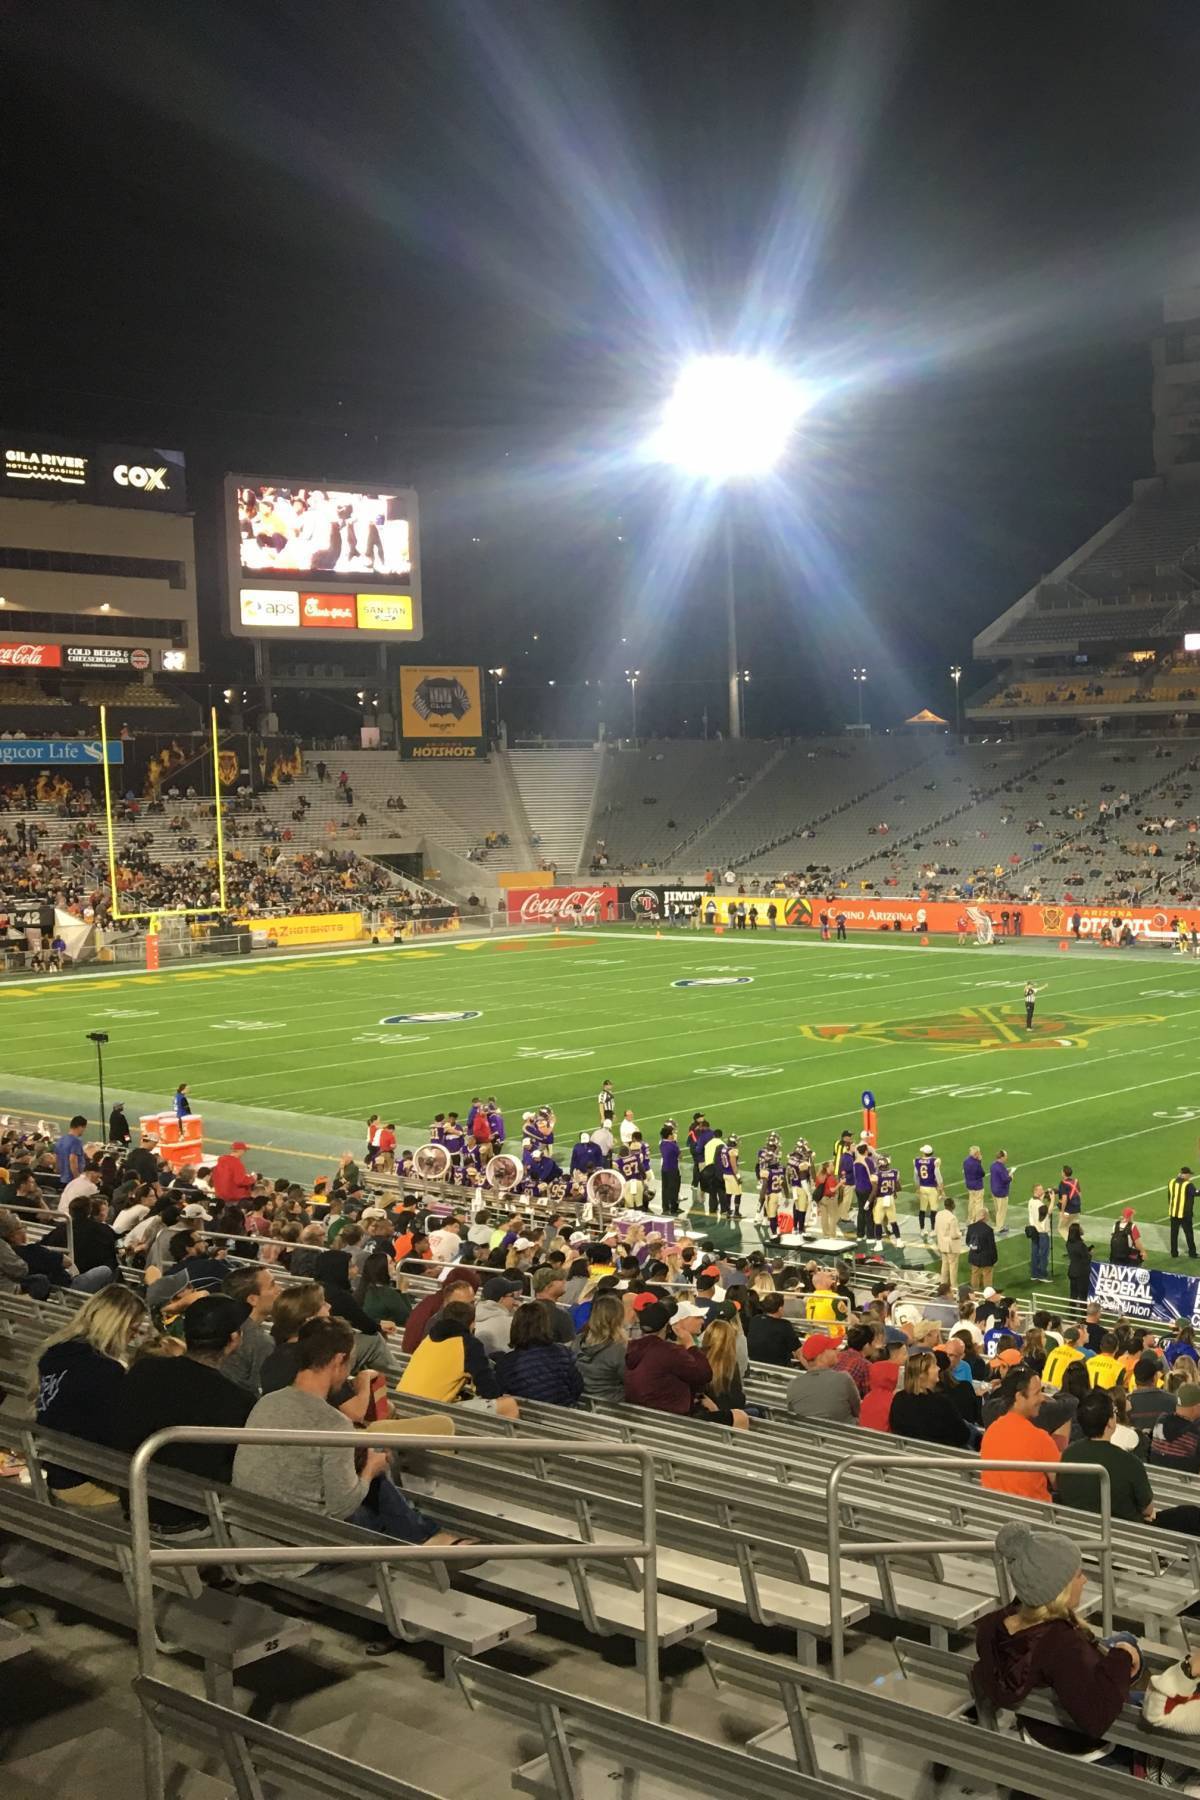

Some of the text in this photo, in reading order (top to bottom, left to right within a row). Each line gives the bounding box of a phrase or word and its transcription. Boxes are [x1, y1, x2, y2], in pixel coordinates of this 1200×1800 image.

[6, 450, 84, 469] GILA RIVER
[6, 463, 38, 471] HOTELS
[50, 467, 85, 476] CASINOS
[113, 464, 168, 491] COX
[265, 601, 294, 616] aps
[67, 648, 91, 656] COLD
[93, 649, 122, 657] BEERS
[68, 655, 129, 664] CHEESEBURGERS
[50, 743, 79, 758] Life
[413, 747, 477, 757] HOTSHOTS
[520, 892, 604, 920] Coca-Cola
[22, 911, 41, 925] 42
[827, 907, 913, 921] CSINO ARIZONA
[1083, 909, 1133, 918] ARIZONA
[907, 1083, 1004, 1097] 40
[622, 1161, 640, 1177] 97
[1100, 1264, 1137, 1283] NAVY
[1095, 1278, 1152, 1299] FEDERAL
[1124, 1301, 1150, 1317] Union
[264, 1639, 280, 1651] 25
